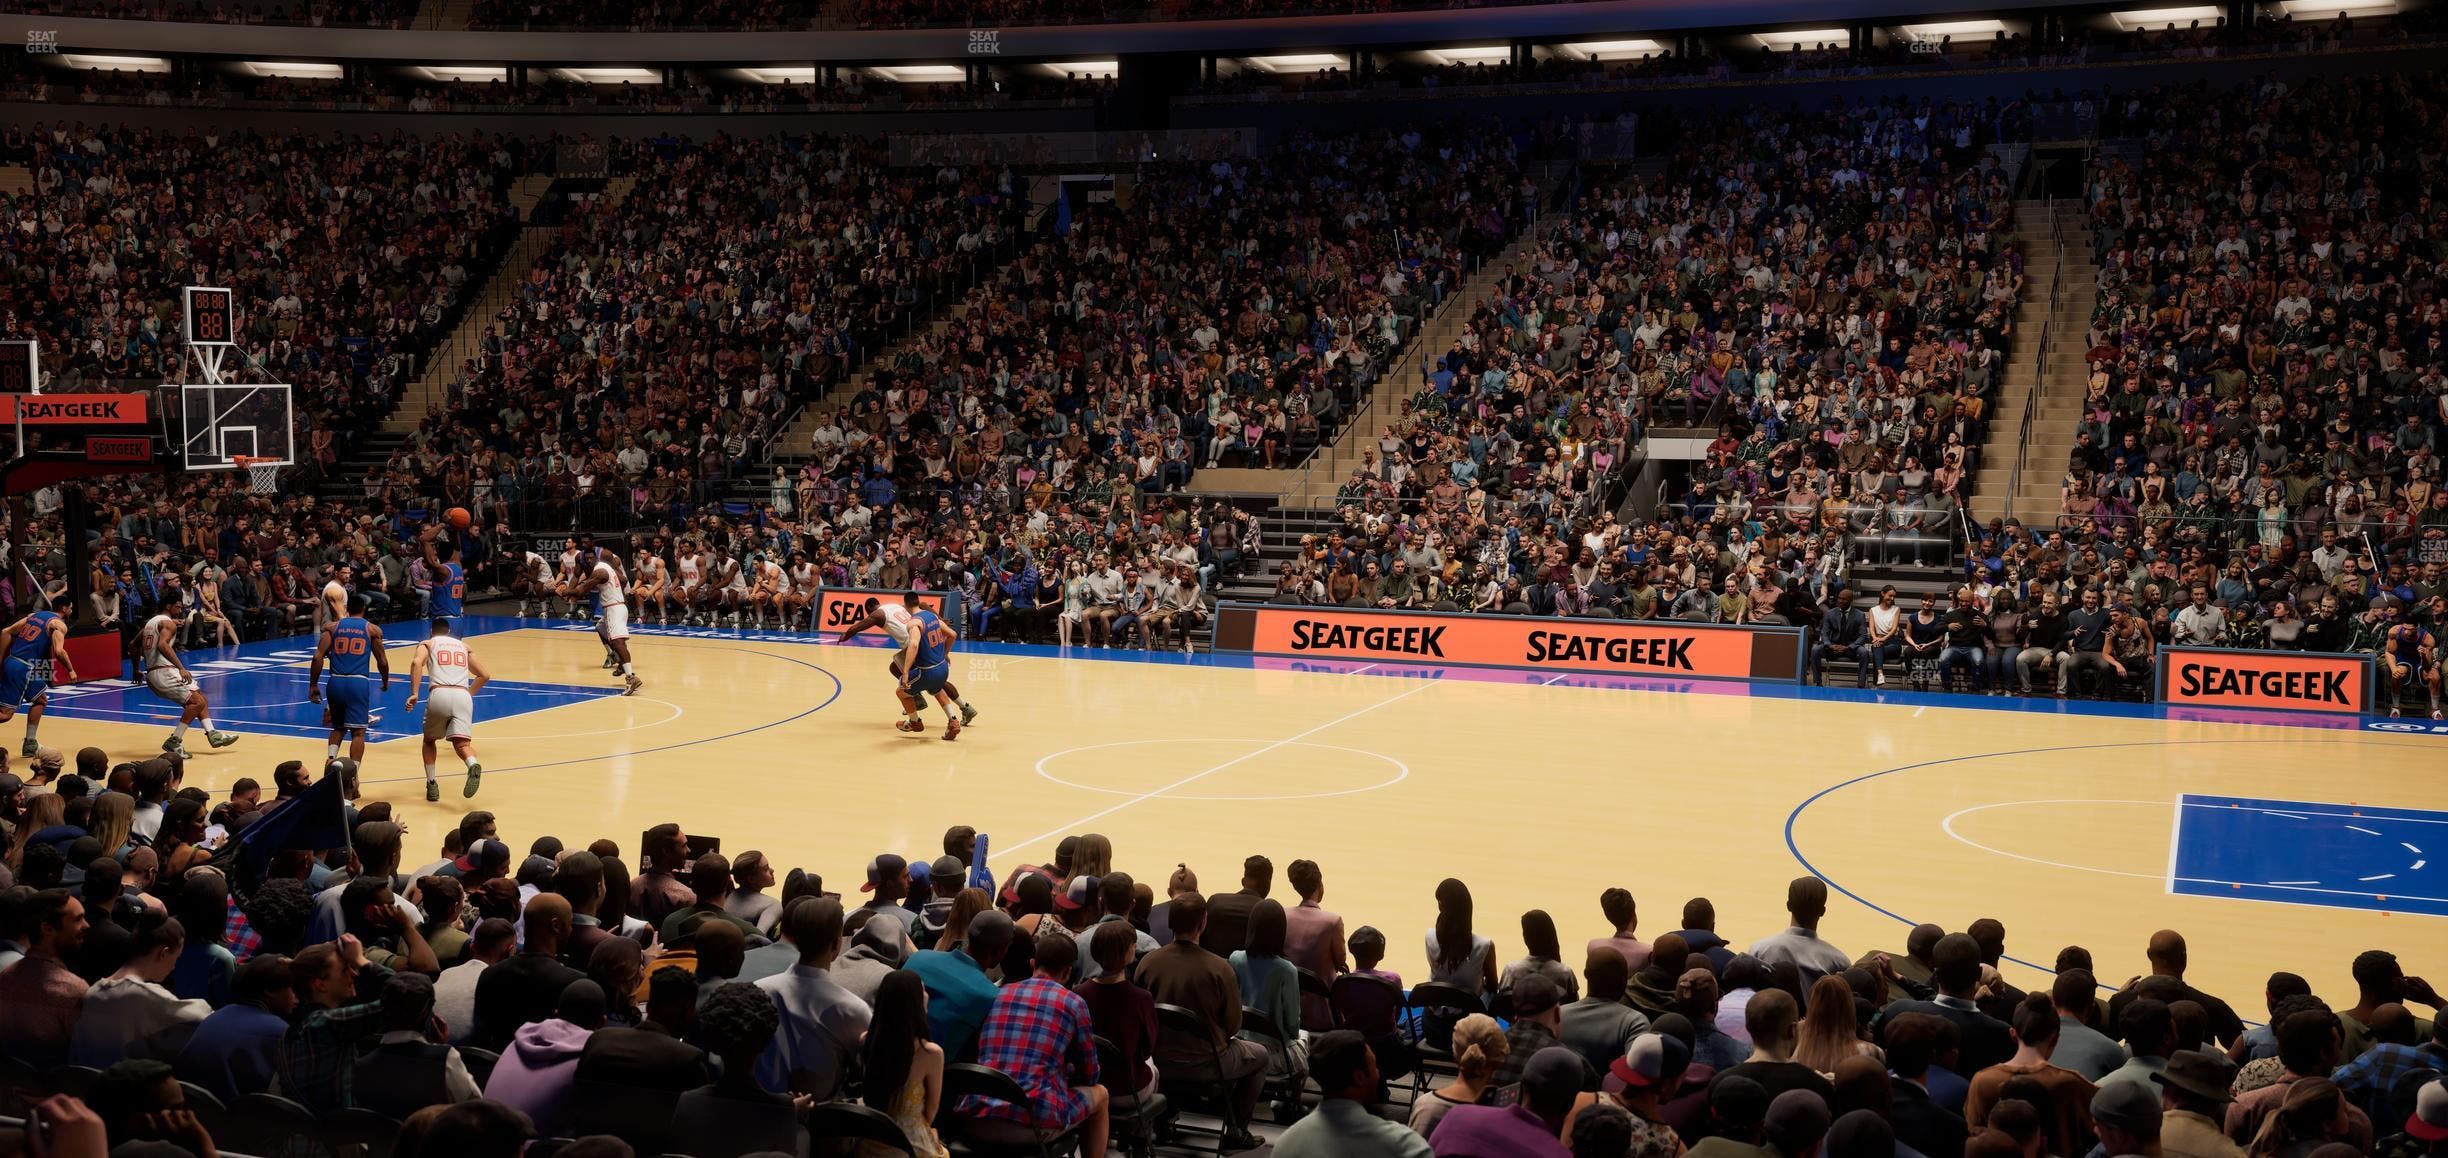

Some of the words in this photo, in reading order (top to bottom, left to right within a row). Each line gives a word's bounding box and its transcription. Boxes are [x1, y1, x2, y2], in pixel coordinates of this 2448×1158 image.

[200, 312, 223, 338] 88
[92, 441, 144, 457] SEATGEEK
[334, 637, 366, 655] 00
[1291, 620, 1446, 657] SEATGEEK
[1526, 630, 1696, 671] SEATGEEK
[437, 650, 466, 667] 00
[2180, 663, 2351, 705] SEATGEEK
